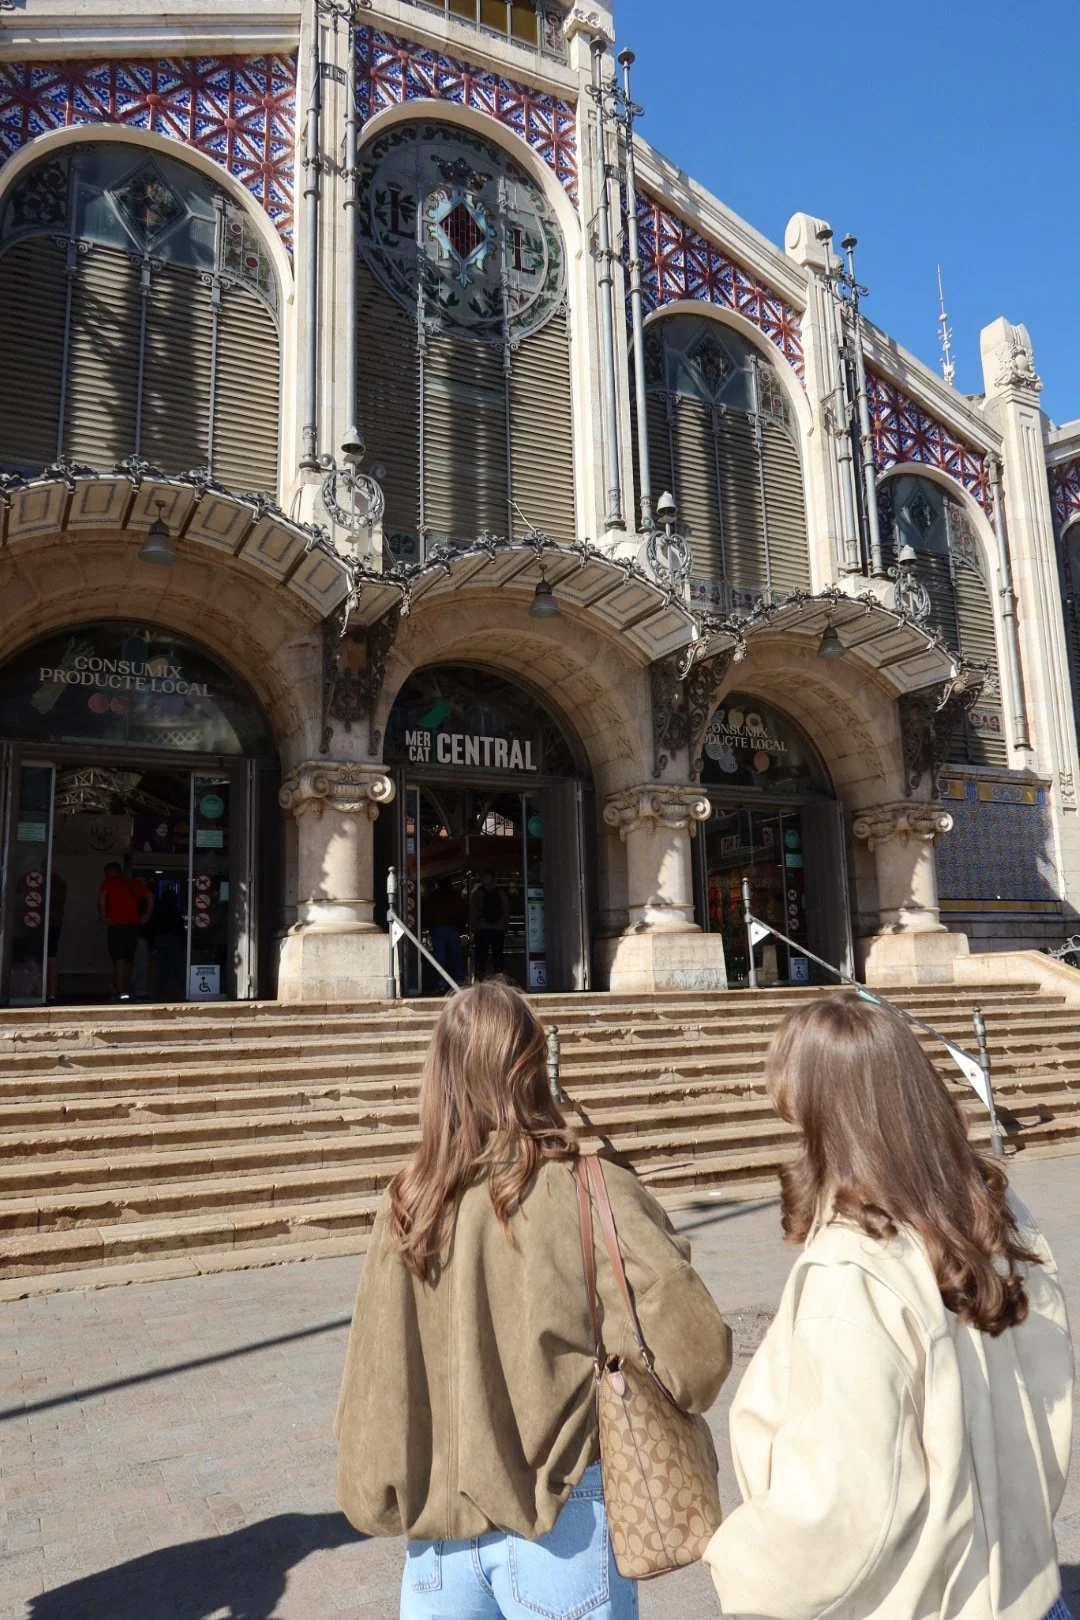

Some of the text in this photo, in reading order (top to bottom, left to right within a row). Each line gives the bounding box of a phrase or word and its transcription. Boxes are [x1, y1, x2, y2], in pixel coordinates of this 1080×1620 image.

[74, 655, 183, 679] CONSUMIX
[39, 667, 214, 698] PRODUCTE LOCAL
[405, 729, 431, 747] MER
[750, 737, 789, 752] LOCAL
[408, 746, 431, 763] CAT
[436, 732, 537, 771] CENTRAL
